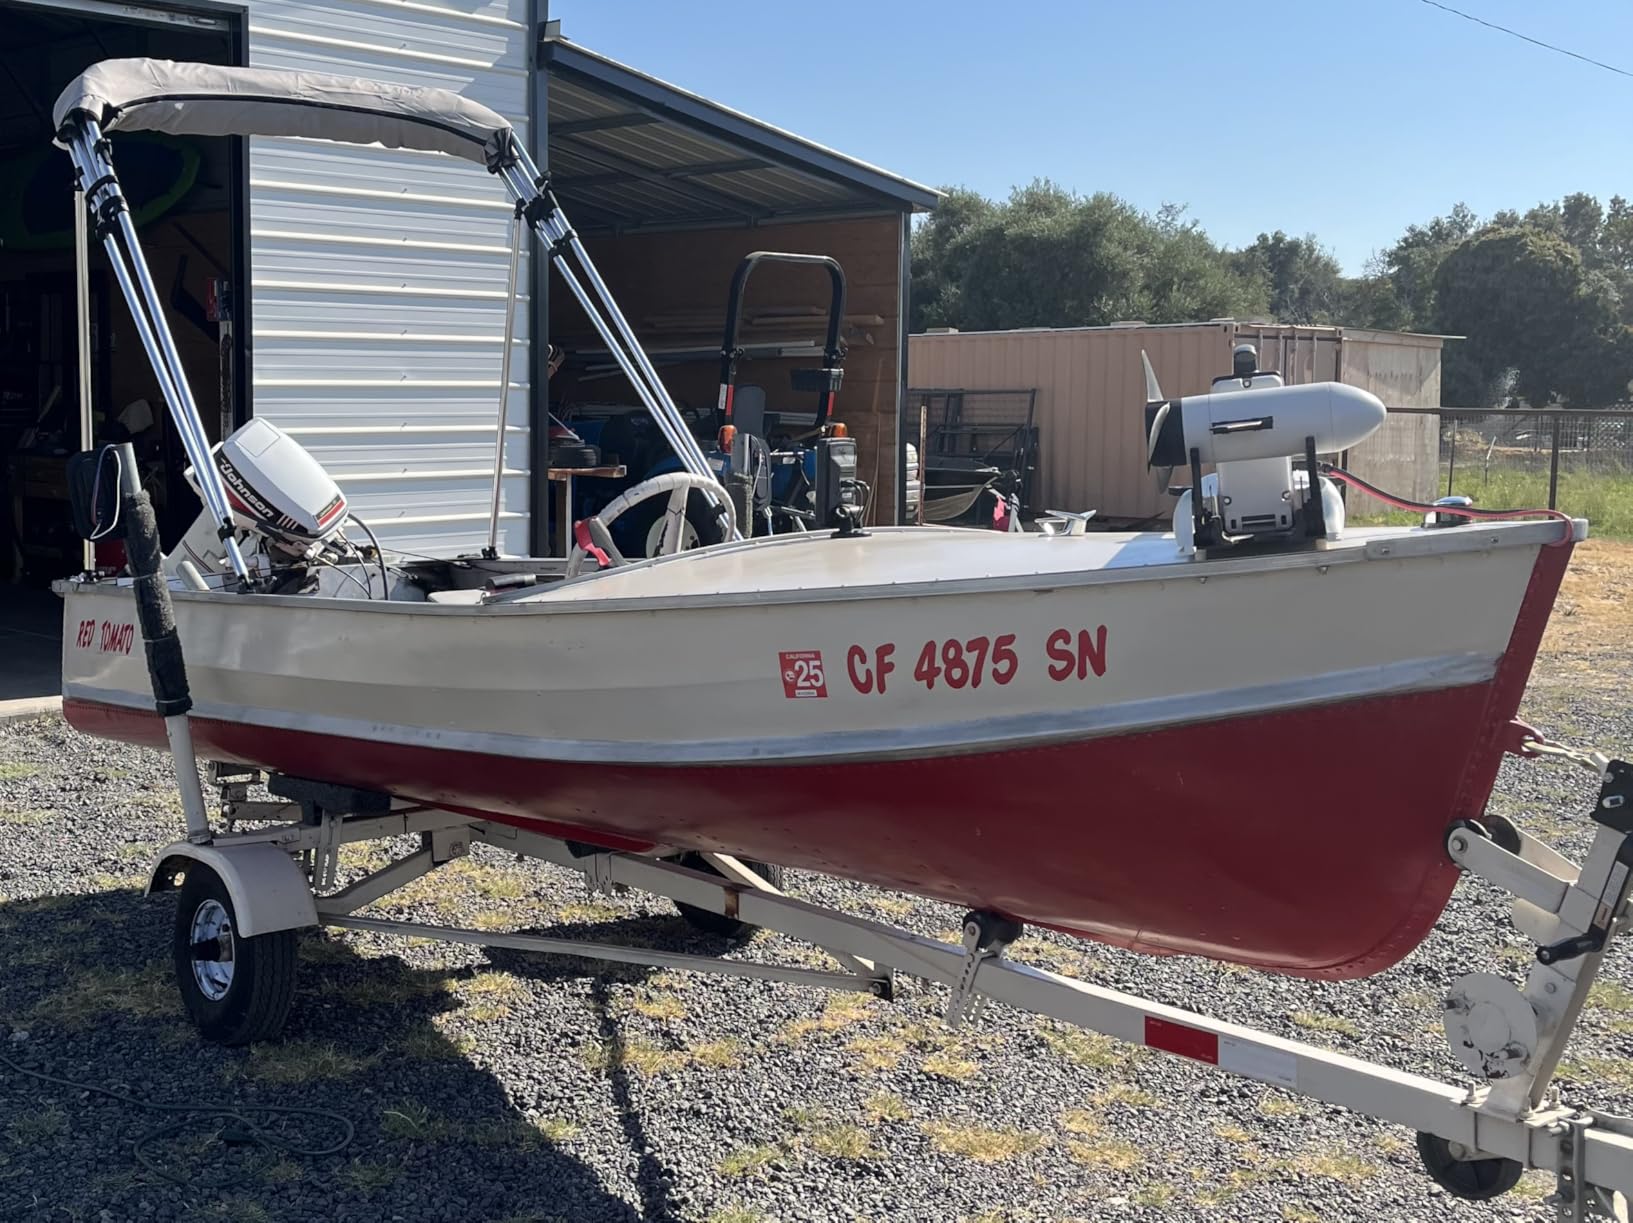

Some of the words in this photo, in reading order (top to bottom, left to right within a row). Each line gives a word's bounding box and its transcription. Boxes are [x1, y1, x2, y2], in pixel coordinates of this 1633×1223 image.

[220, 461, 274, 517] Johnson
[76, 619, 95, 648] RED
[100, 620, 134, 655] TOMATO
[847, 643, 895, 694] CF
[914, 633, 1018, 689] 4875
[1046, 624, 1107, 681] SN
[794, 660, 824, 687] 25
